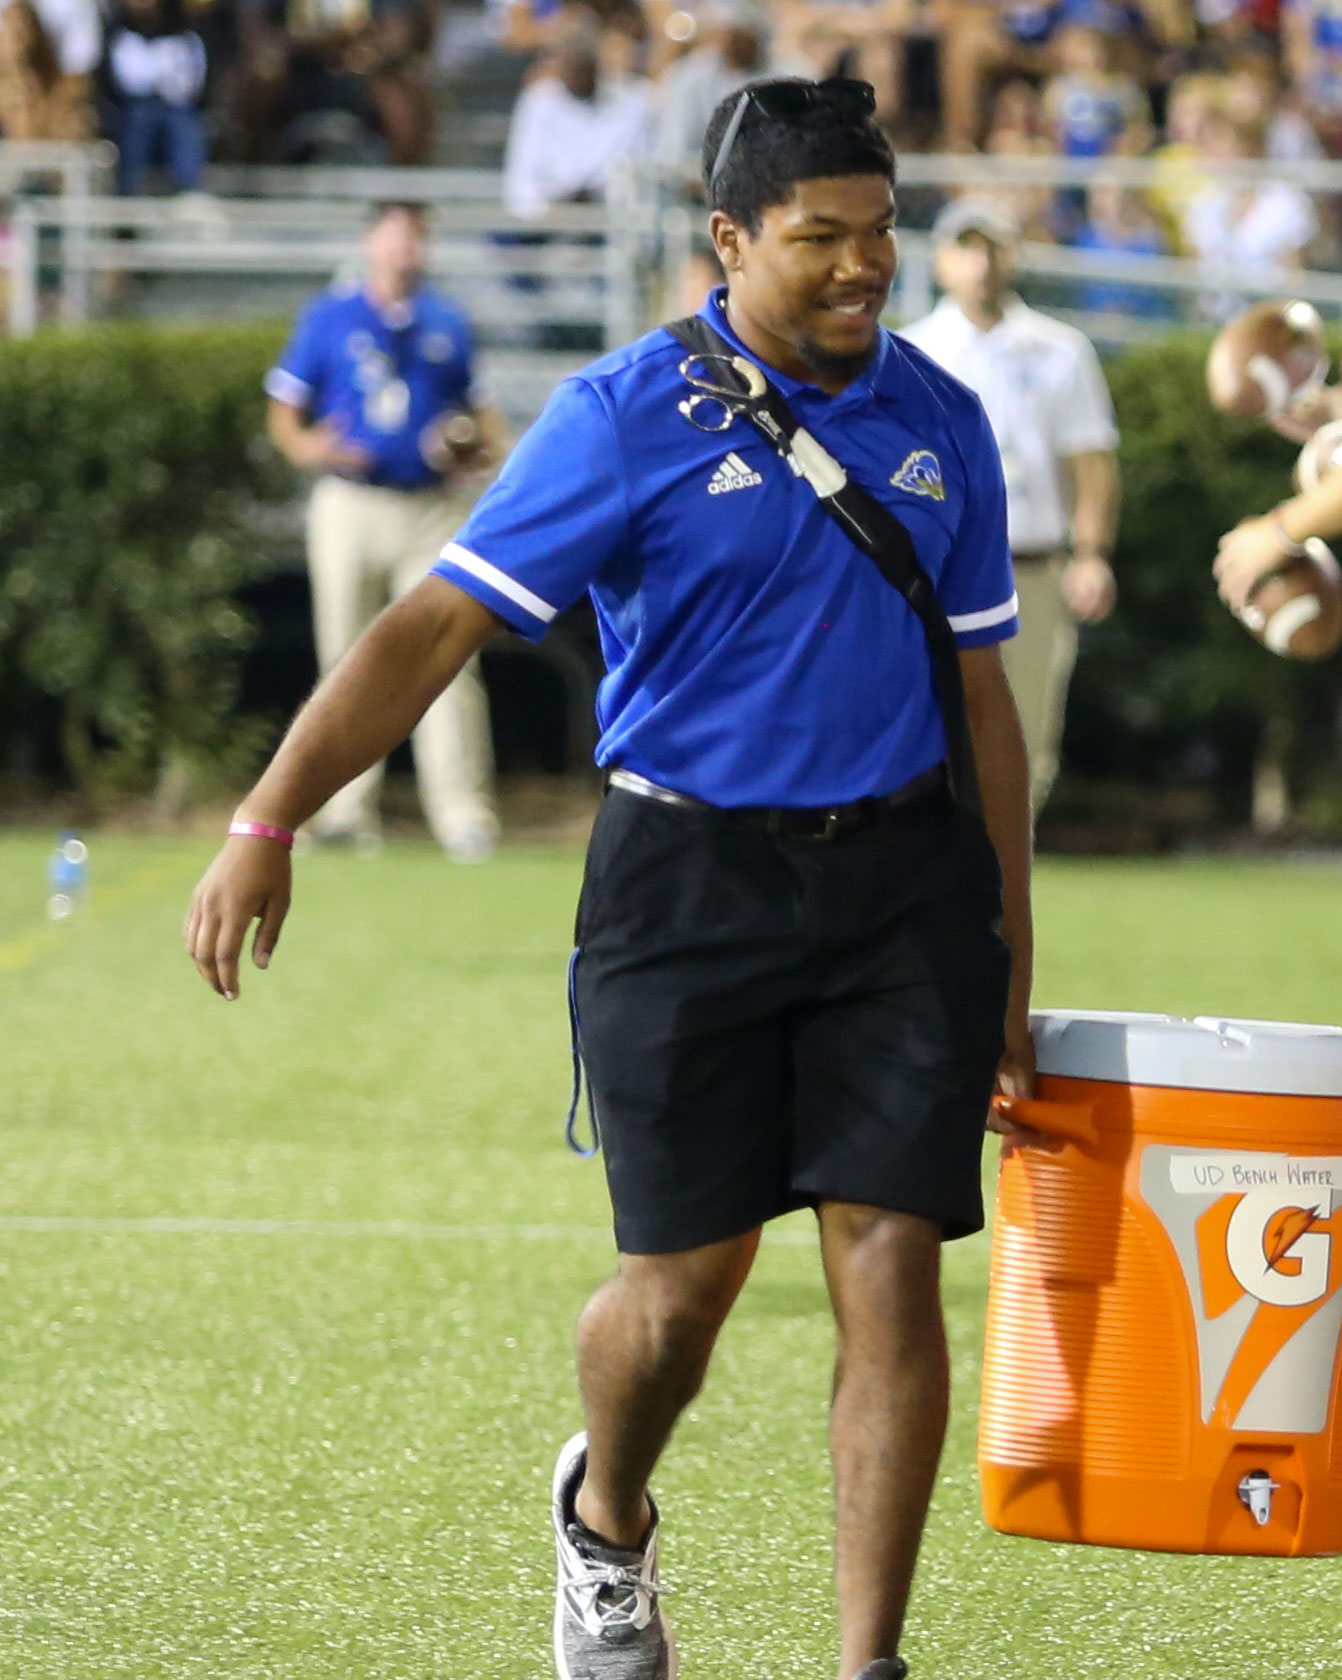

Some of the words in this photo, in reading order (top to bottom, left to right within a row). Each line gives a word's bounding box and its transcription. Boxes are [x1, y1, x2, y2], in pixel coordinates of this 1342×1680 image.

[708, 472, 762, 494] adidas
[1193, 1165, 1225, 1186] UD
[1226, 1188, 1332, 1306] G
